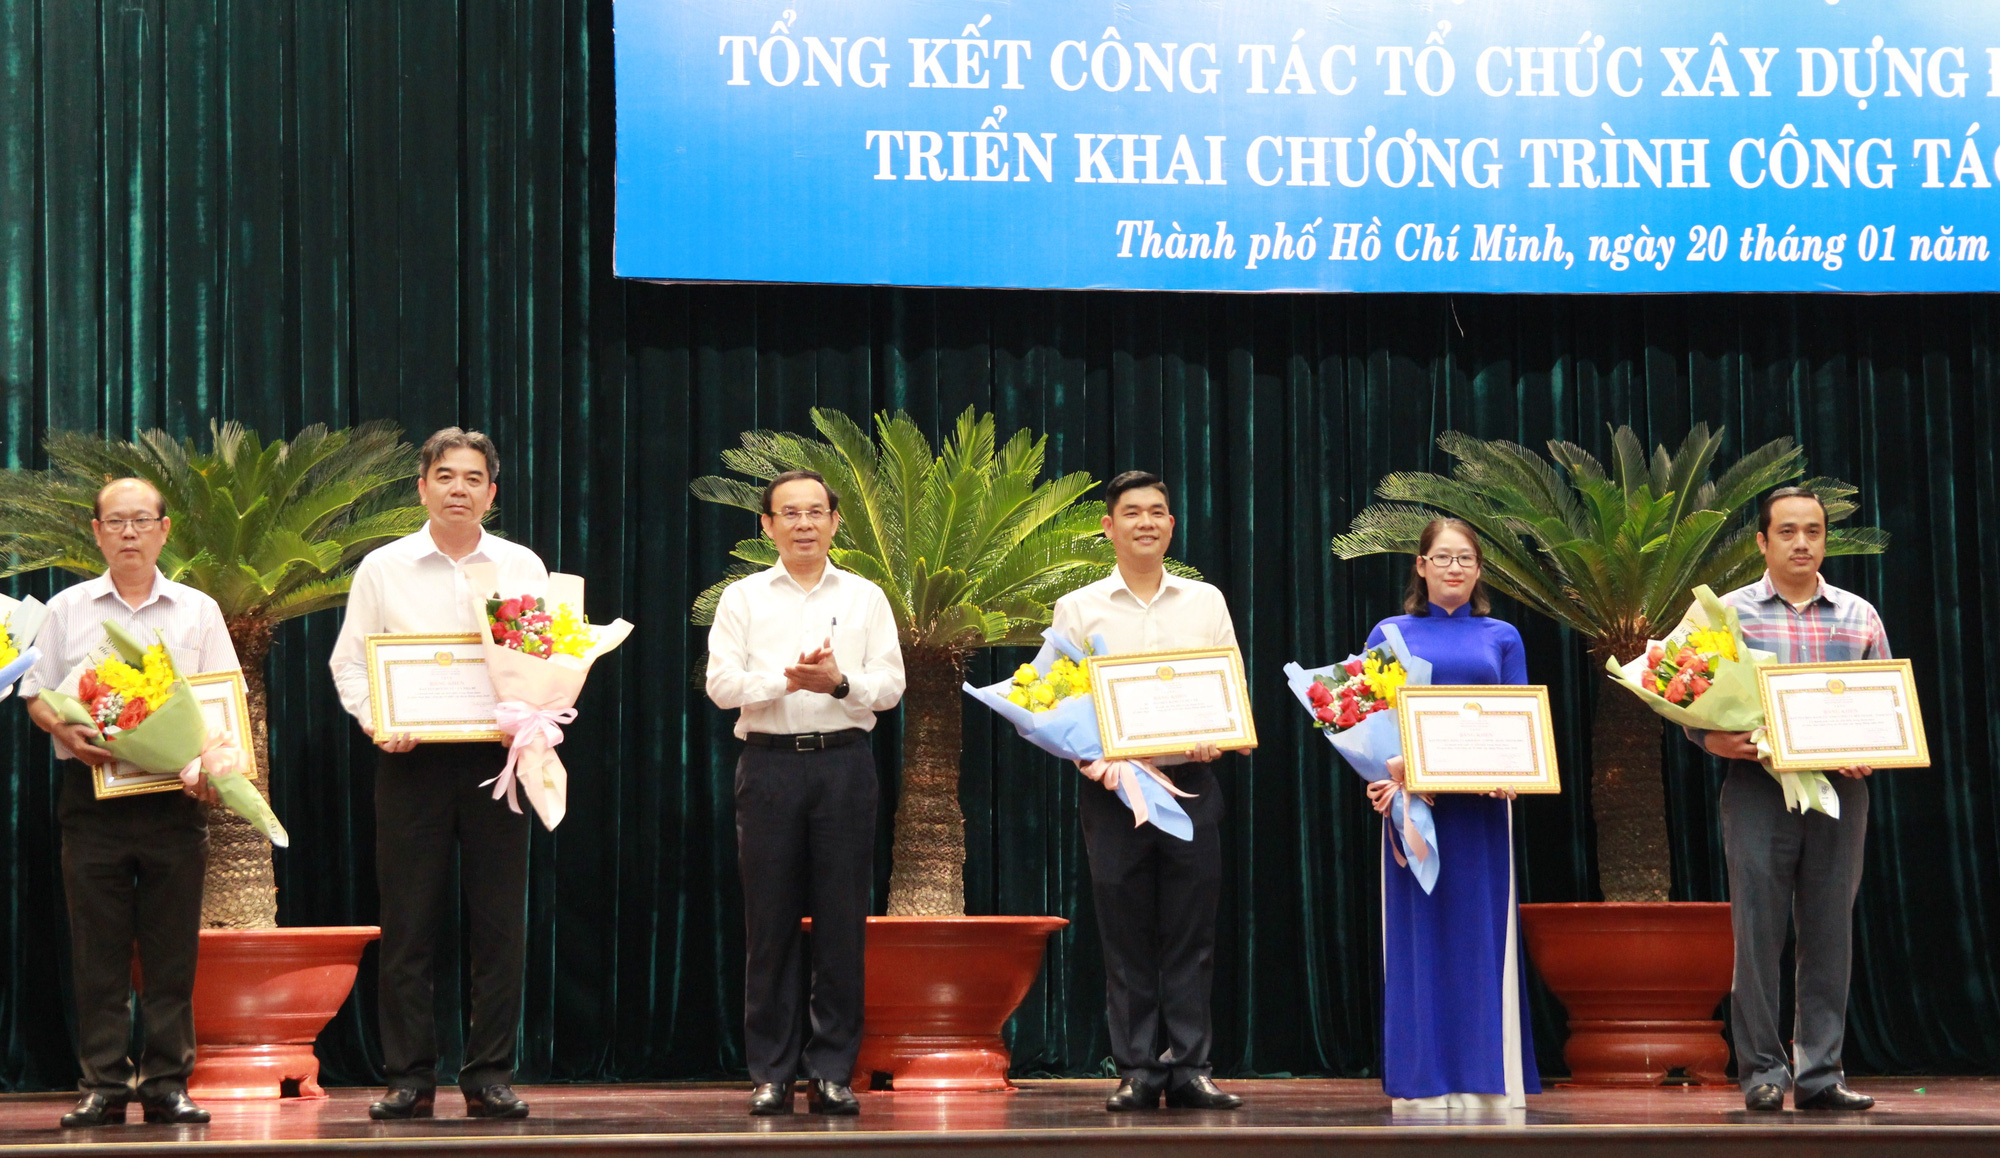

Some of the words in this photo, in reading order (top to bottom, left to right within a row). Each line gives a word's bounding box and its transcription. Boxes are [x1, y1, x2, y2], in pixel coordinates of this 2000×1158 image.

[719, 9, 890, 88] TỔNG
[908, 14, 1031, 89] KẾT
[1050, 27, 1221, 94] CÔNG
[1238, 28, 1357, 95] TÁC
[1376, 20, 1455, 96] TỔ
[1475, 31, 1643, 97] CHỨC
[1660, 32, 1779, 96] XÂY
[1796, 35, 1969, 110] DỰNG
[866, 105, 1057, 182] TRIỂN
[1075, 134, 1227, 185] KHAI
[1246, 125, 1503, 188] CHƯƠNG
[1520, 122, 1710, 189] TRÌNH
[1729, 124, 1897, 189] CÔNG
[1913, 122, 2000, 188] TÁ
[1116, 220, 1236, 259] Thành
[1245, 217, 1322, 269] phố
[1328, 216, 1381, 261] Hồ
[1395, 223, 1460, 261] Chí
[1470, 224, 1574, 270] Minh,
[1588, 224, 1675, 271] ngày
[1687, 225, 1728, 261] 20
[1740, 224, 1847, 271] tháng
[1858, 225, 1895, 261] 01
[1910, 226, 1989, 261] năm
